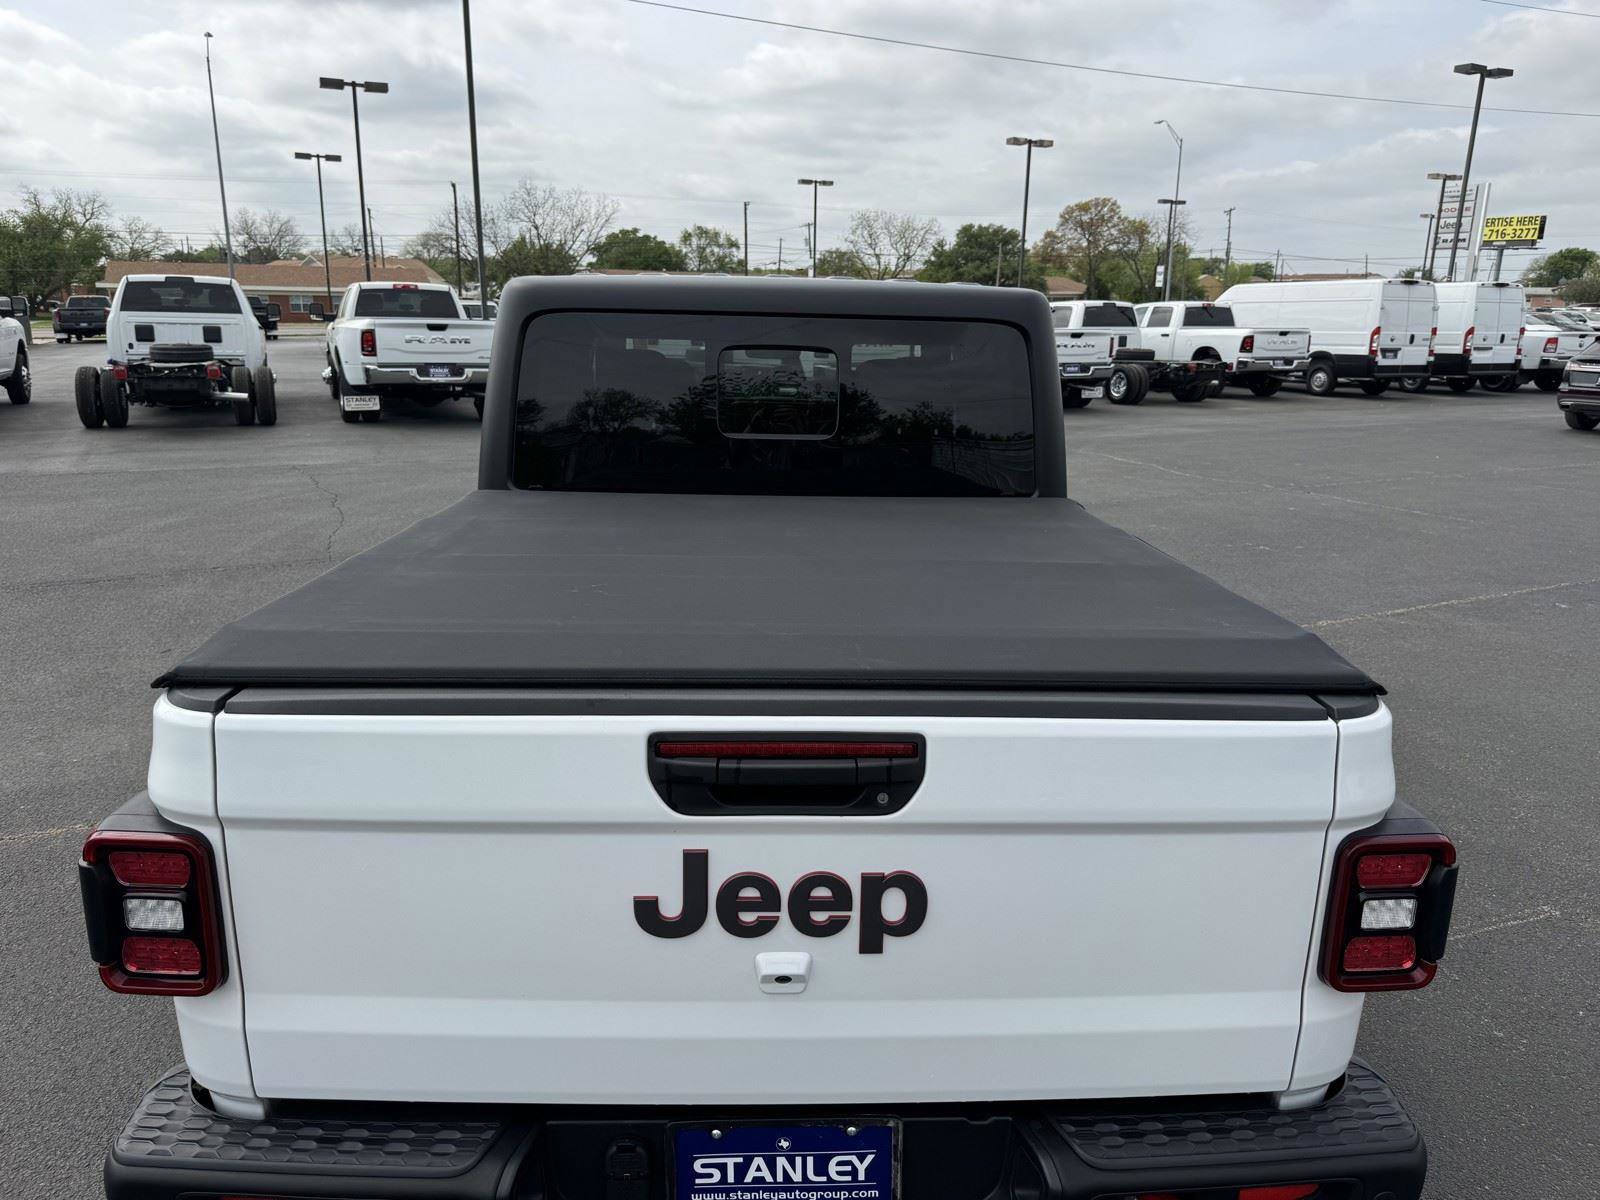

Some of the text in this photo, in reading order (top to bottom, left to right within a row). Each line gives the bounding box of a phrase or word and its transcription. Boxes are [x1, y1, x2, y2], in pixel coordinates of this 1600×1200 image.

[1485, 215, 1540, 228] ERTISE HERE
[1484, 227, 1538, 239] -716-3277
[633, 848, 928, 955] Jeep
[692, 1154, 876, 1184] STANLEY
[691, 1189, 879, 1200] www.stanleyautogroup.com
